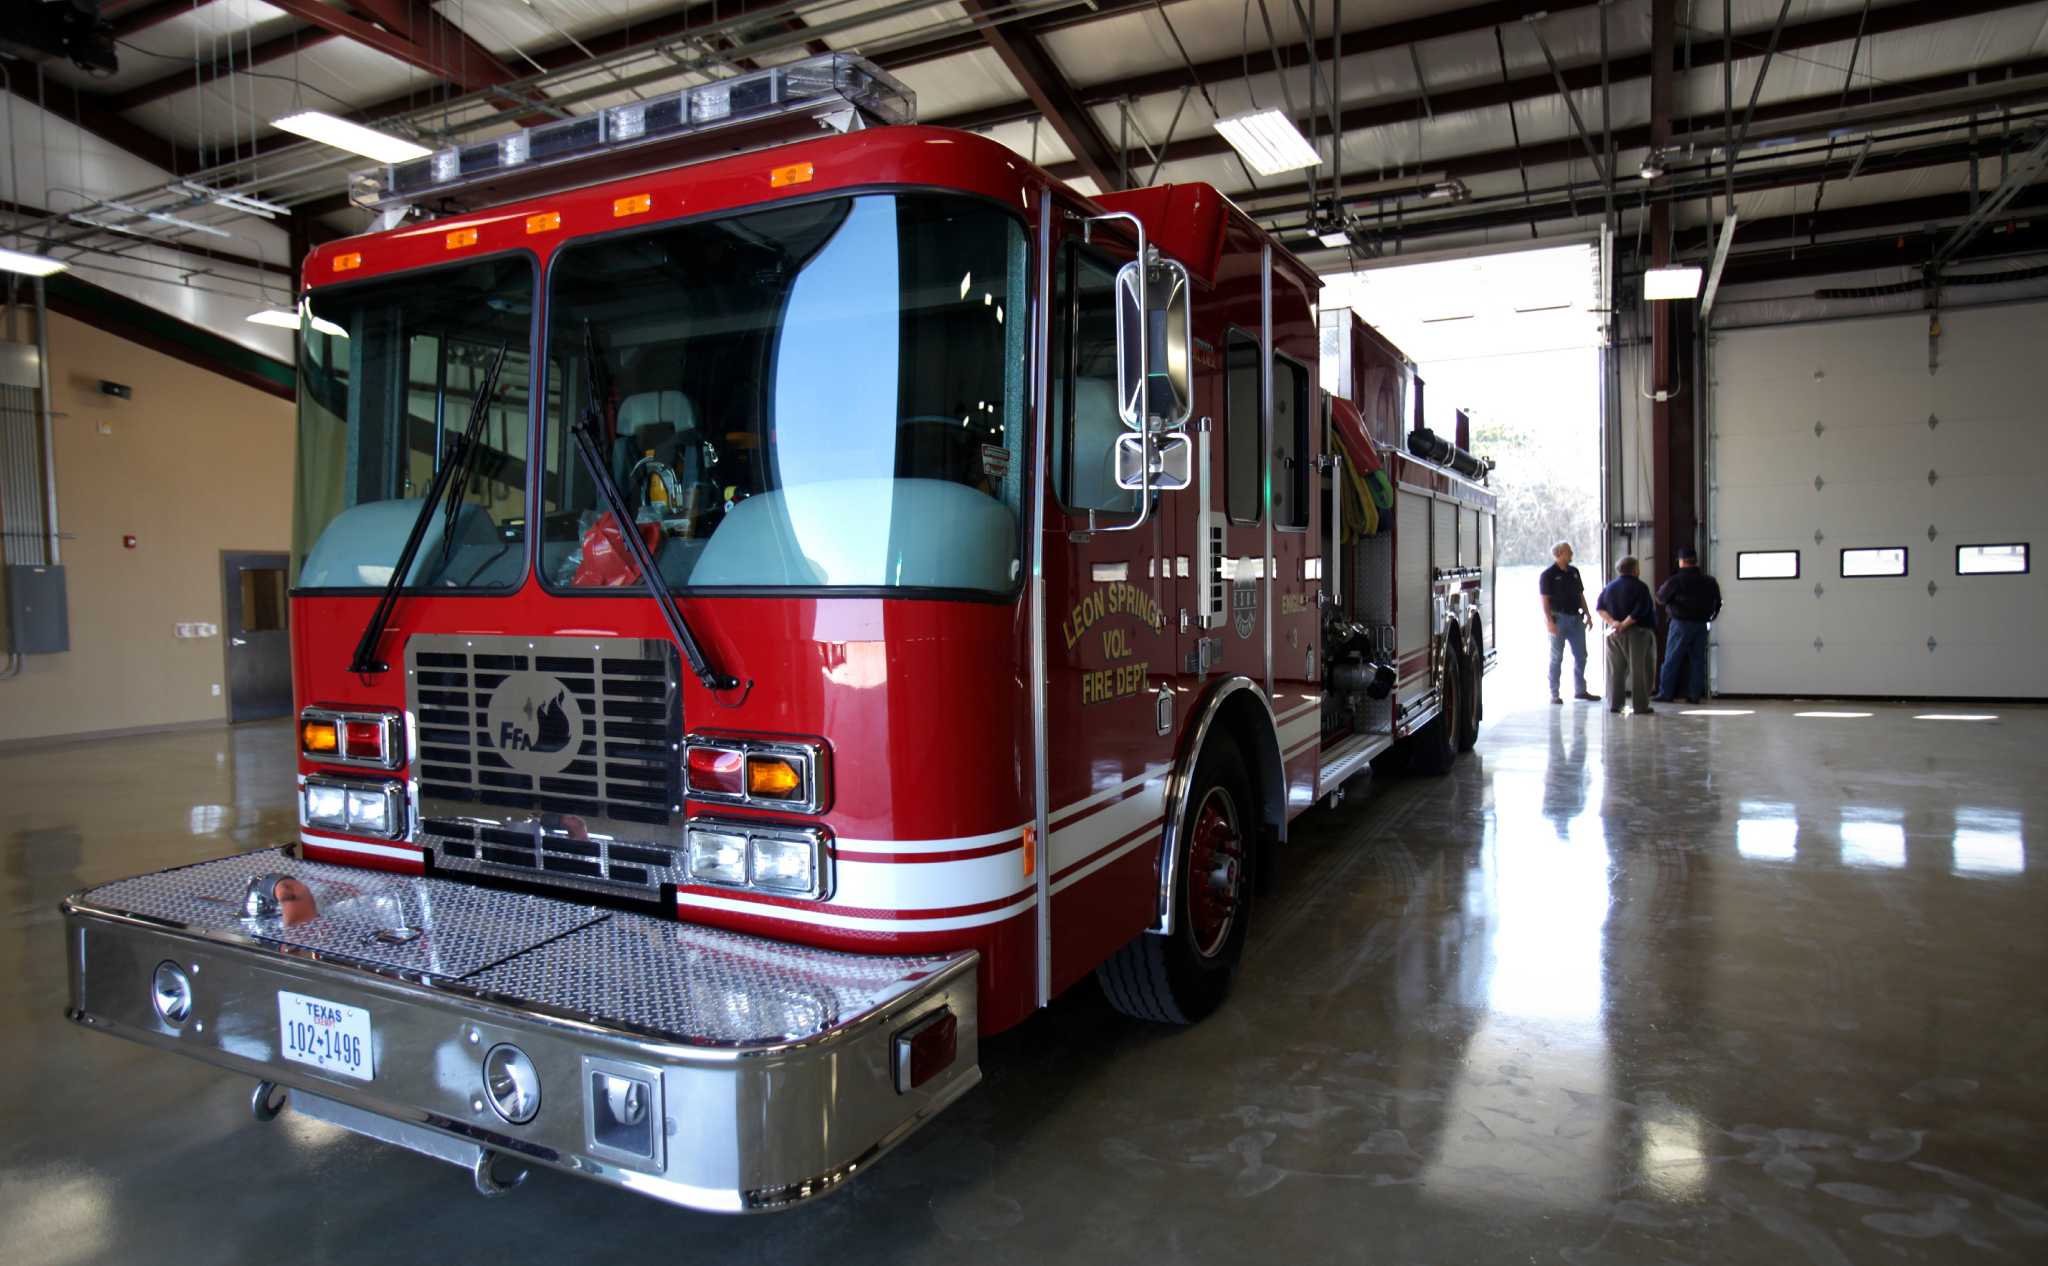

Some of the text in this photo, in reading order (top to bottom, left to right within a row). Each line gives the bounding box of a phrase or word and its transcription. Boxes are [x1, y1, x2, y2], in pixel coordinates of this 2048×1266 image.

[1063, 582, 1163, 650] LEON SPRINGS
[1103, 629, 1132, 659] VOL.
[1082, 663, 1150, 704] FIRE DEPT.
[500, 722, 533, 751] FFA
[306, 1003, 342, 1022] TEXAS
